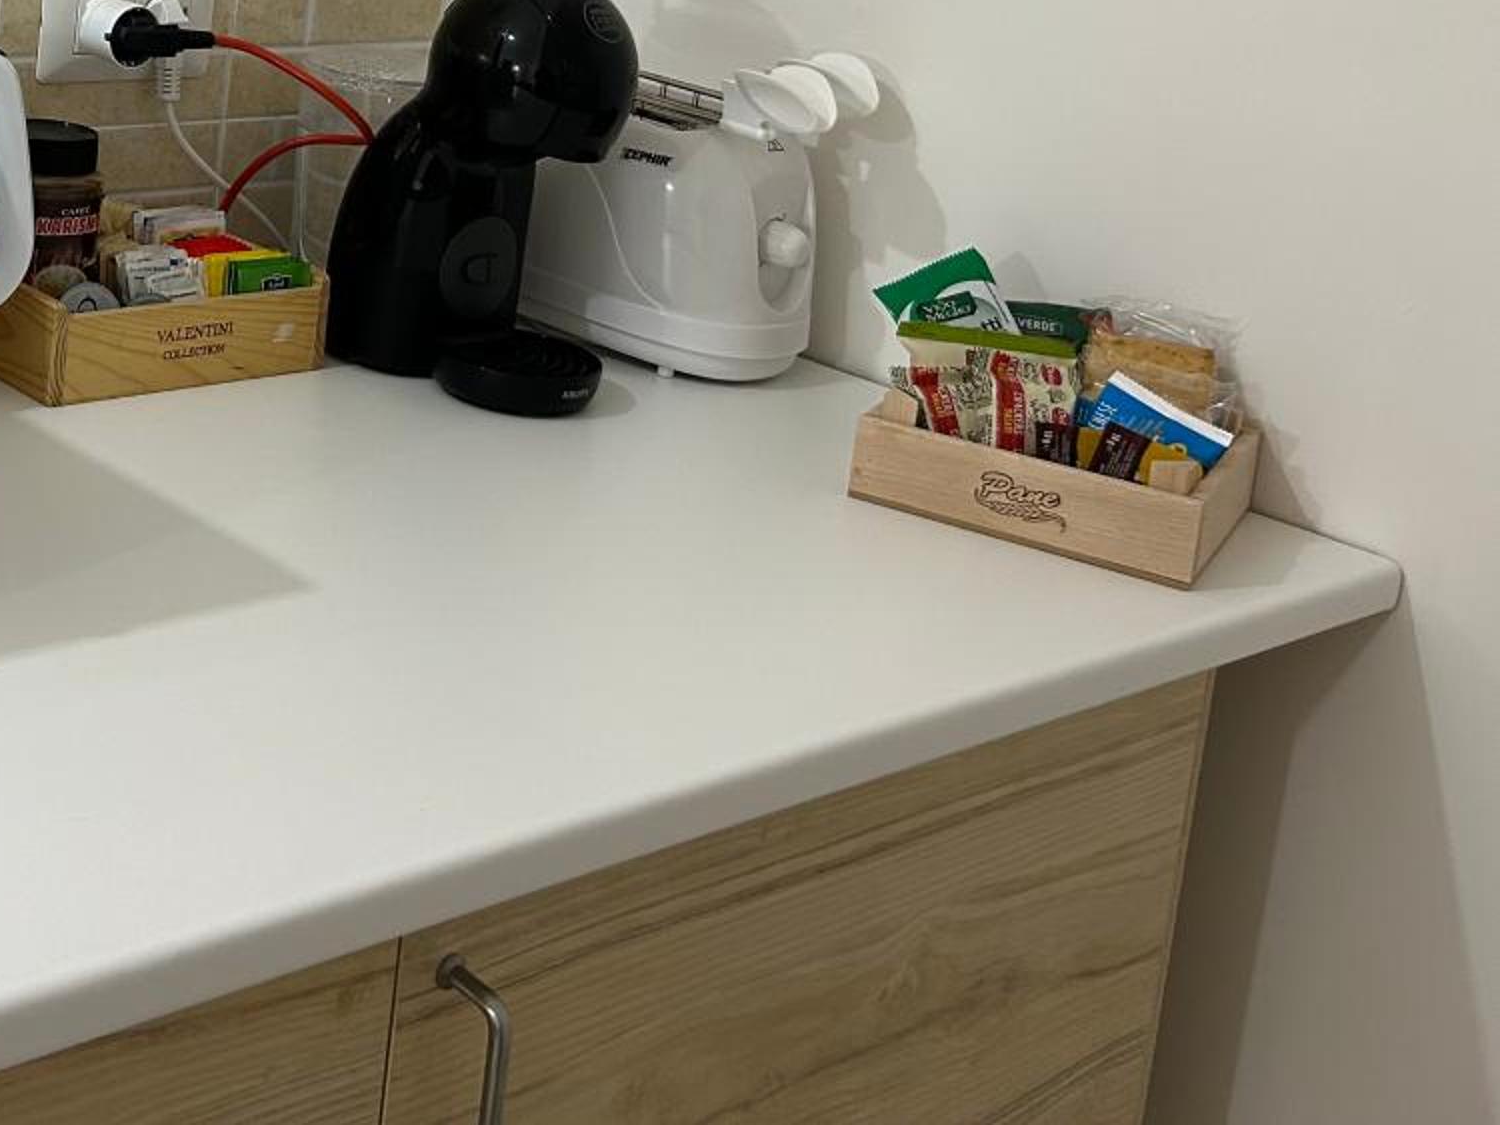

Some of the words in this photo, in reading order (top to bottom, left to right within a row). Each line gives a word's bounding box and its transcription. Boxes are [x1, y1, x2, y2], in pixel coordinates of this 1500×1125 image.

[157, 321, 233, 343] VALENTINI
[163, 344, 225, 360] COLLECTION
[980, 470, 1061, 509] Pane
